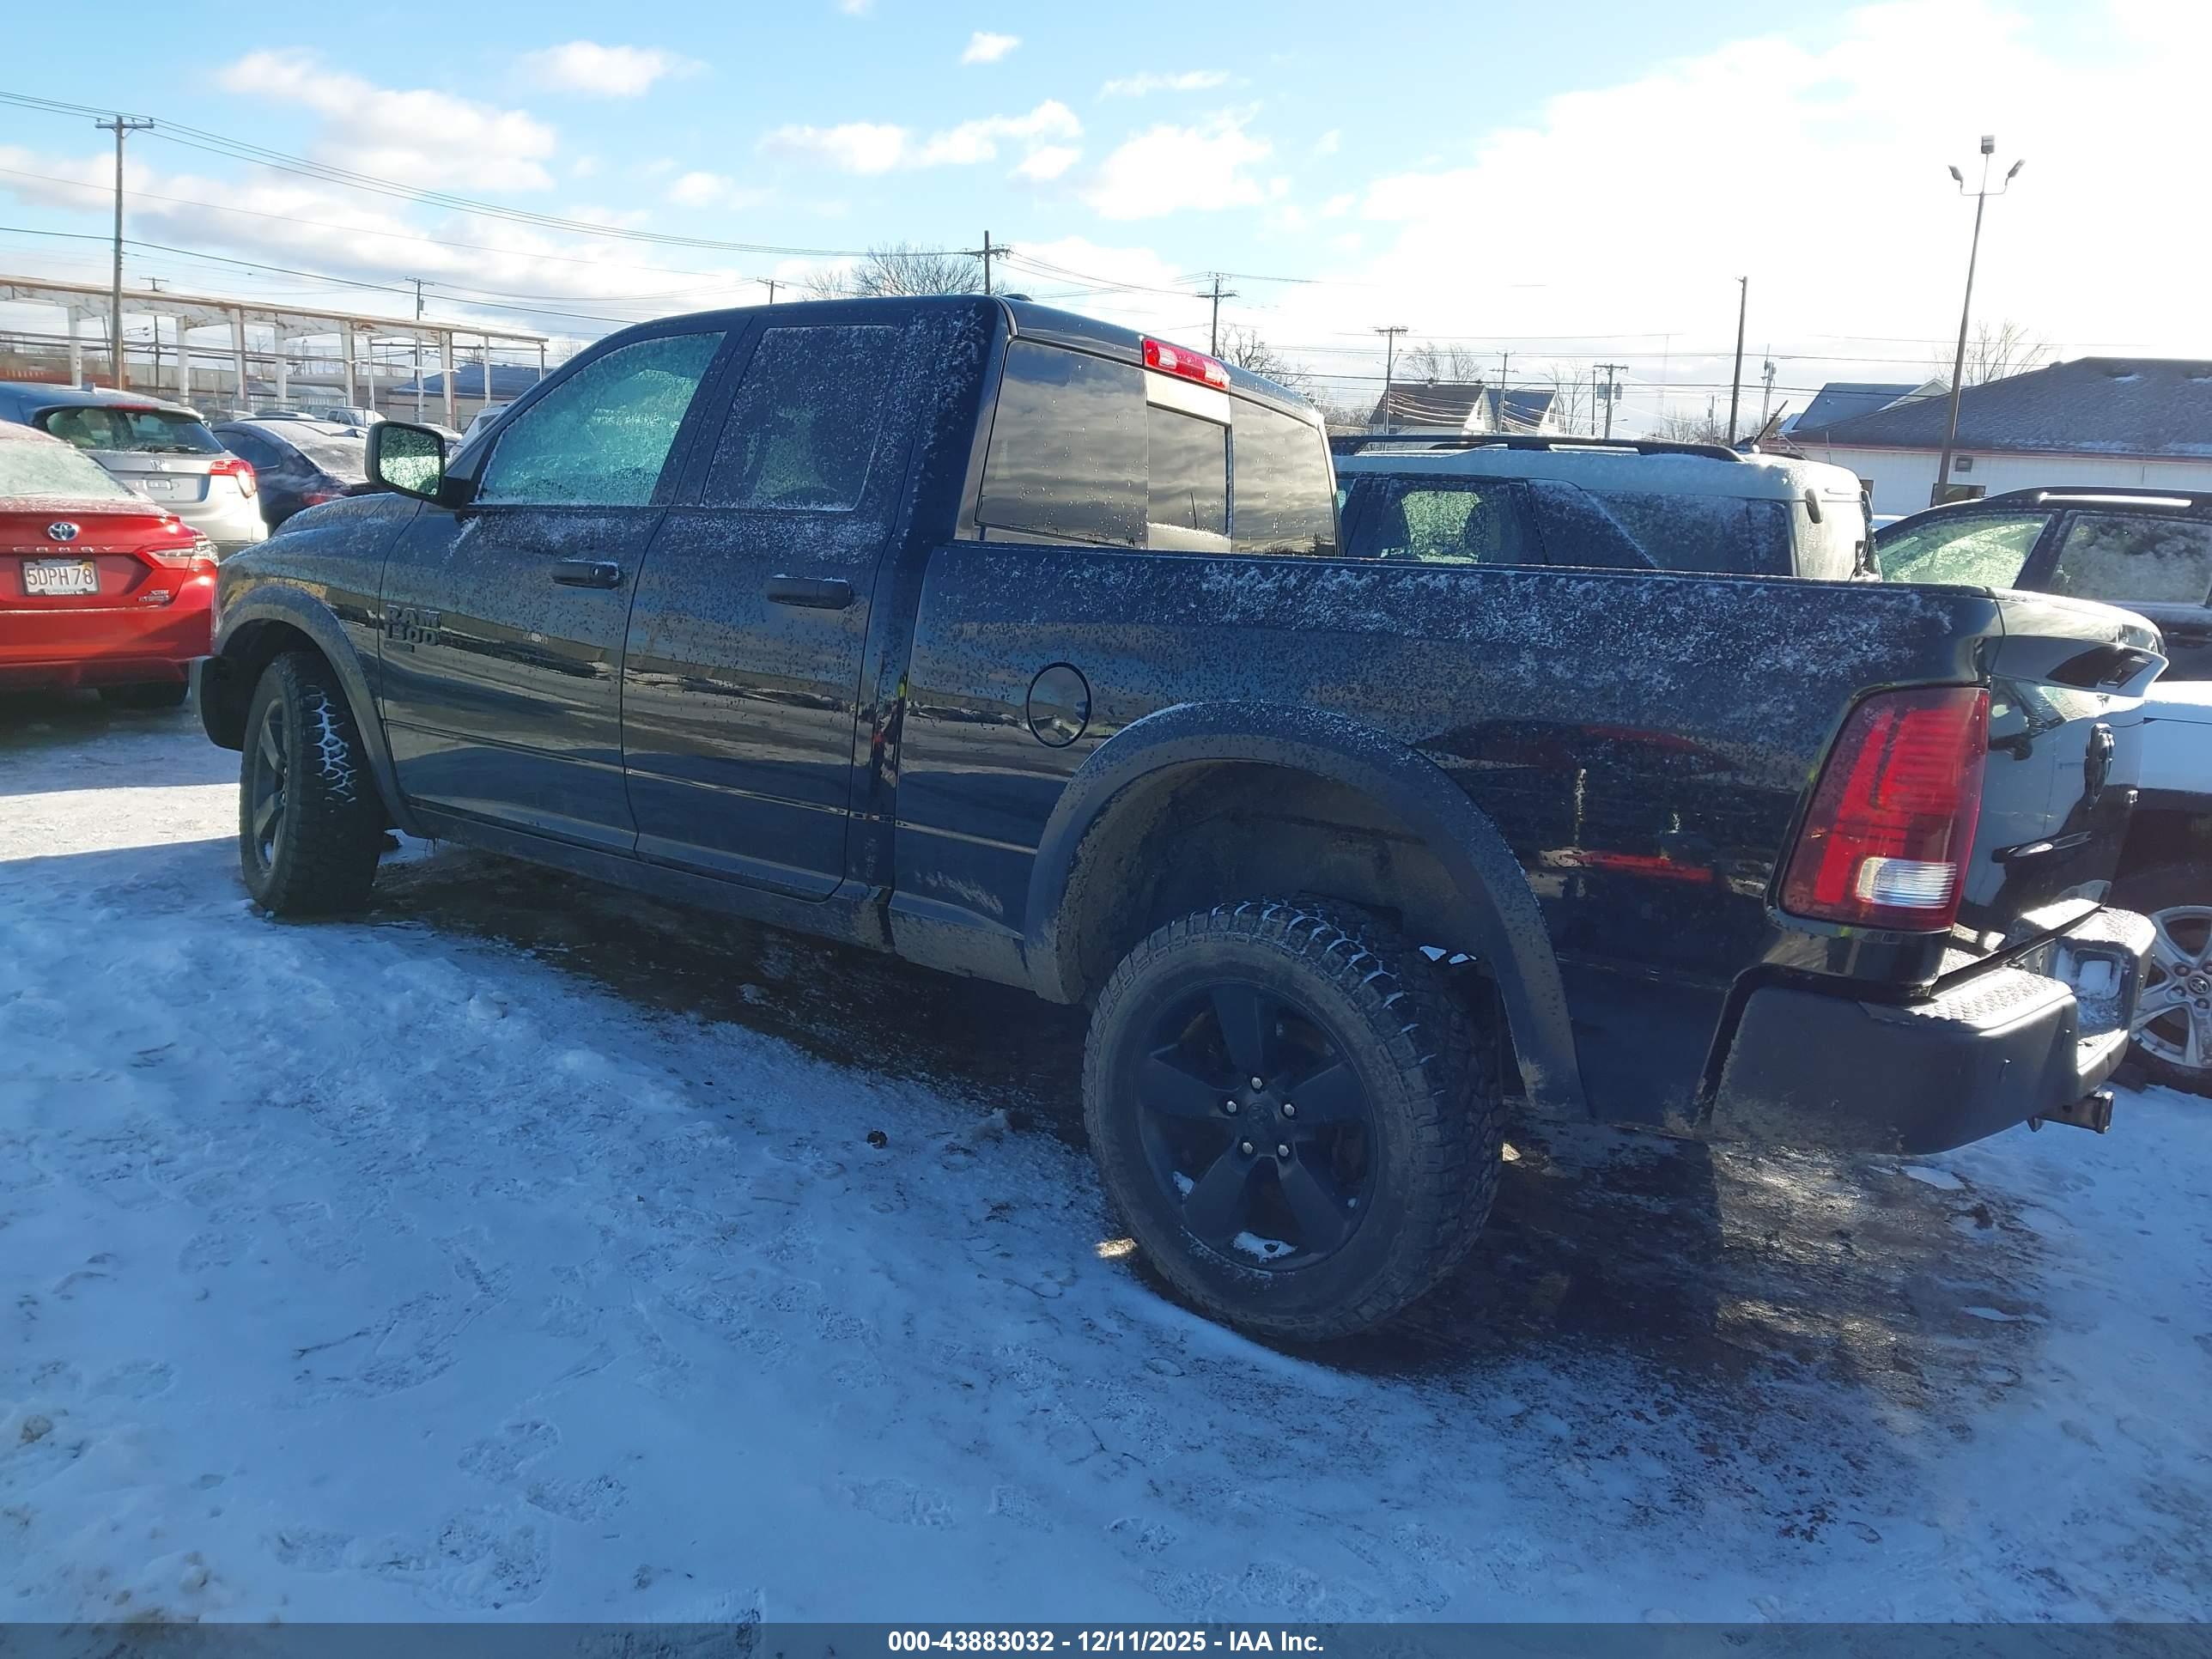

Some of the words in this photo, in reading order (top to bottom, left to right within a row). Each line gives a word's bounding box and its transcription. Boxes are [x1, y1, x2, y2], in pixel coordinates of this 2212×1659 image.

[27, 568, 70, 586] 5DPH
[71, 568, 94, 585] 78
[384, 604, 441, 627] RAM
[384, 623, 440, 646] 1500
